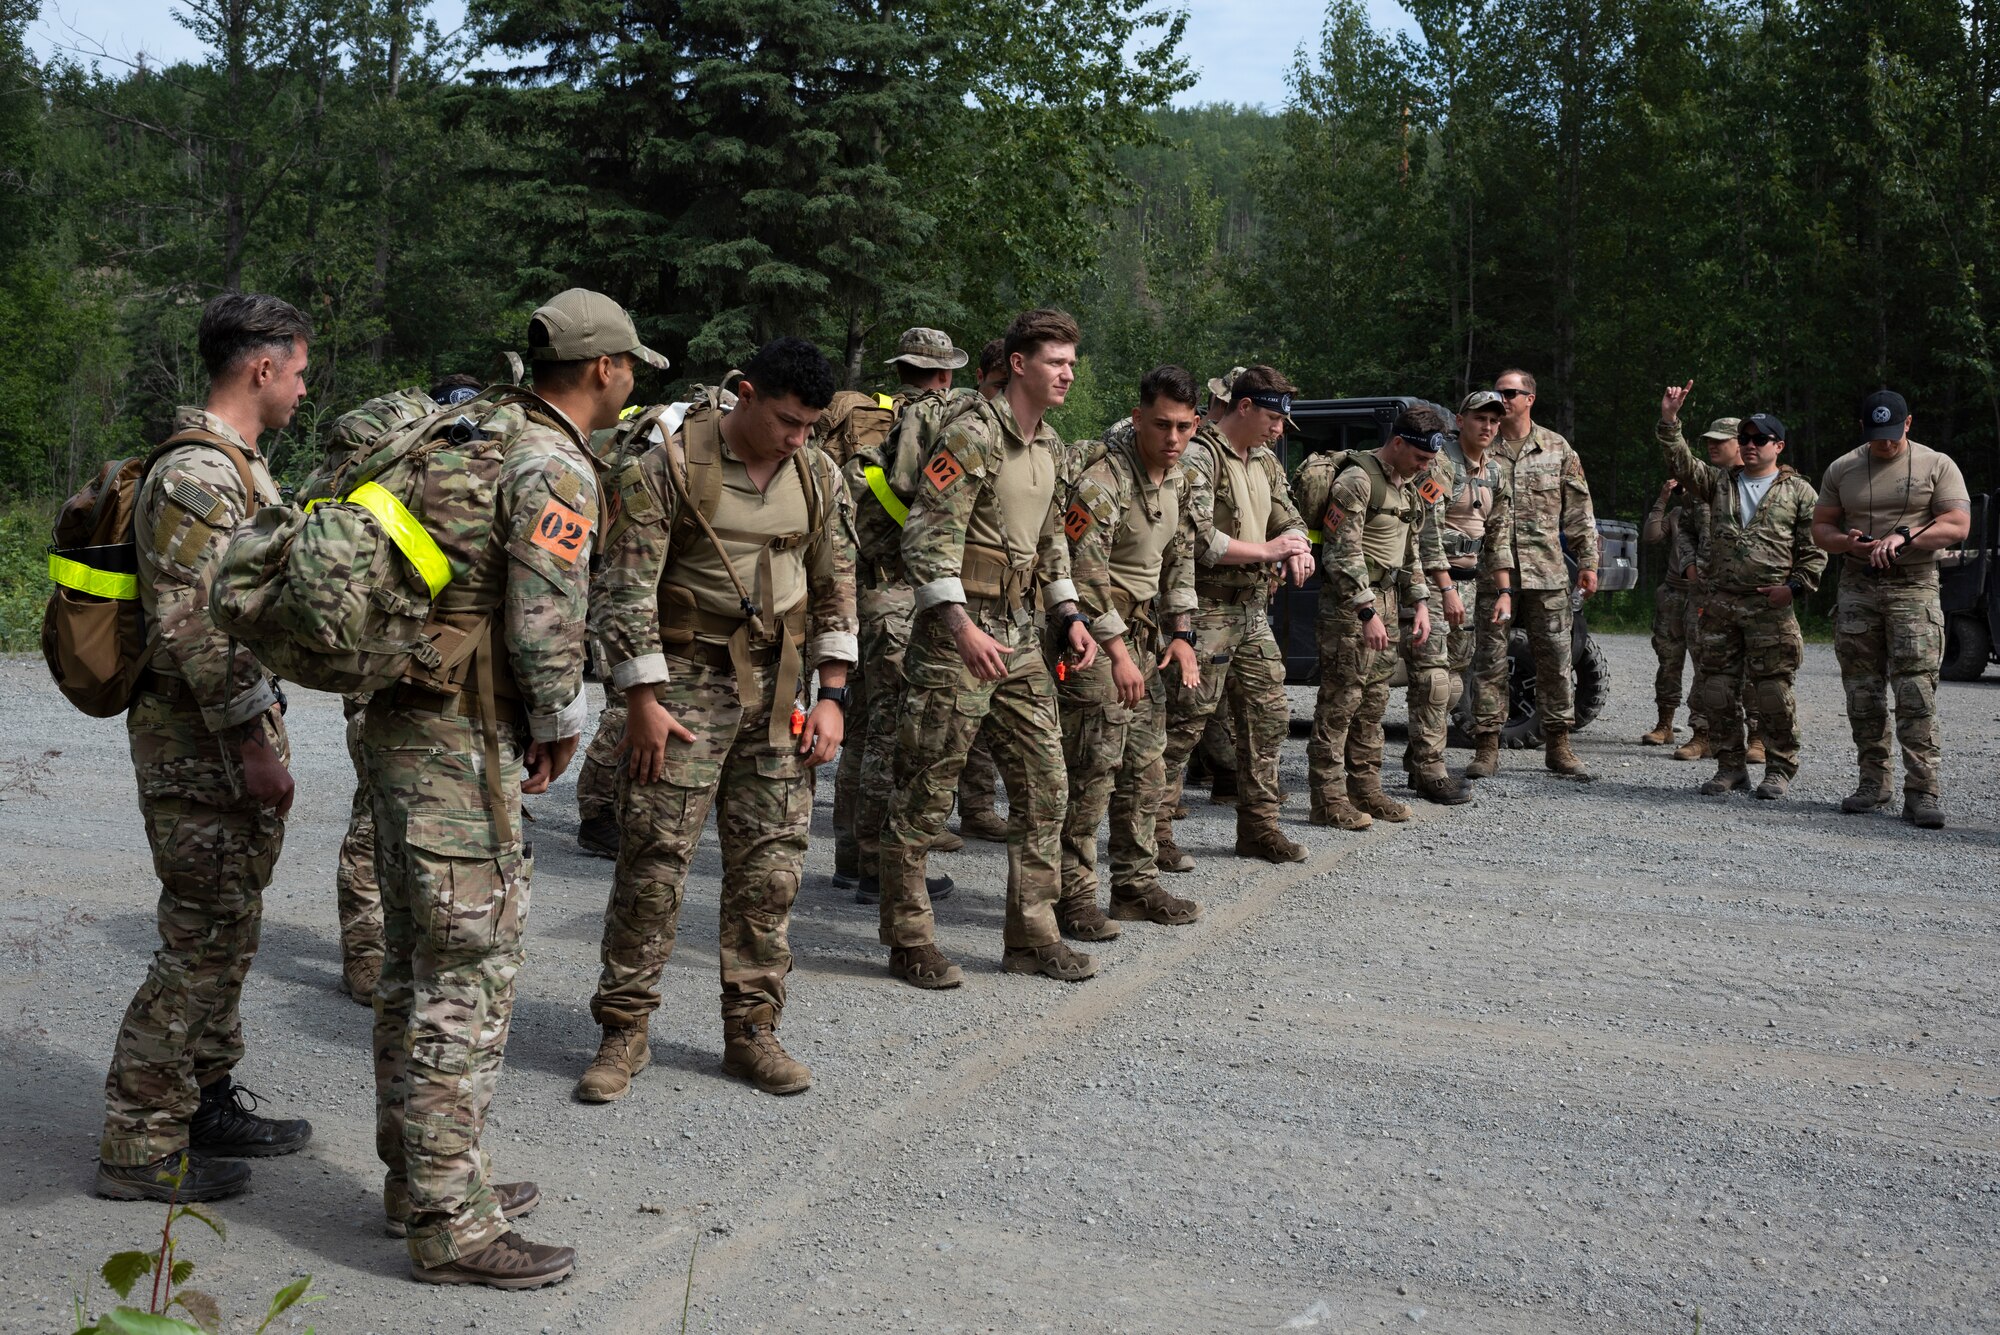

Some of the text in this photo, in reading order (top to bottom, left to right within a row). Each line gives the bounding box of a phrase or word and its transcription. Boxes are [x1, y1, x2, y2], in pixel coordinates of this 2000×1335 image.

[932, 457, 957, 482] 07
[1423, 482, 1440, 499] 01
[541, 512, 583, 550] 02
[1066, 511, 1088, 533] 07
